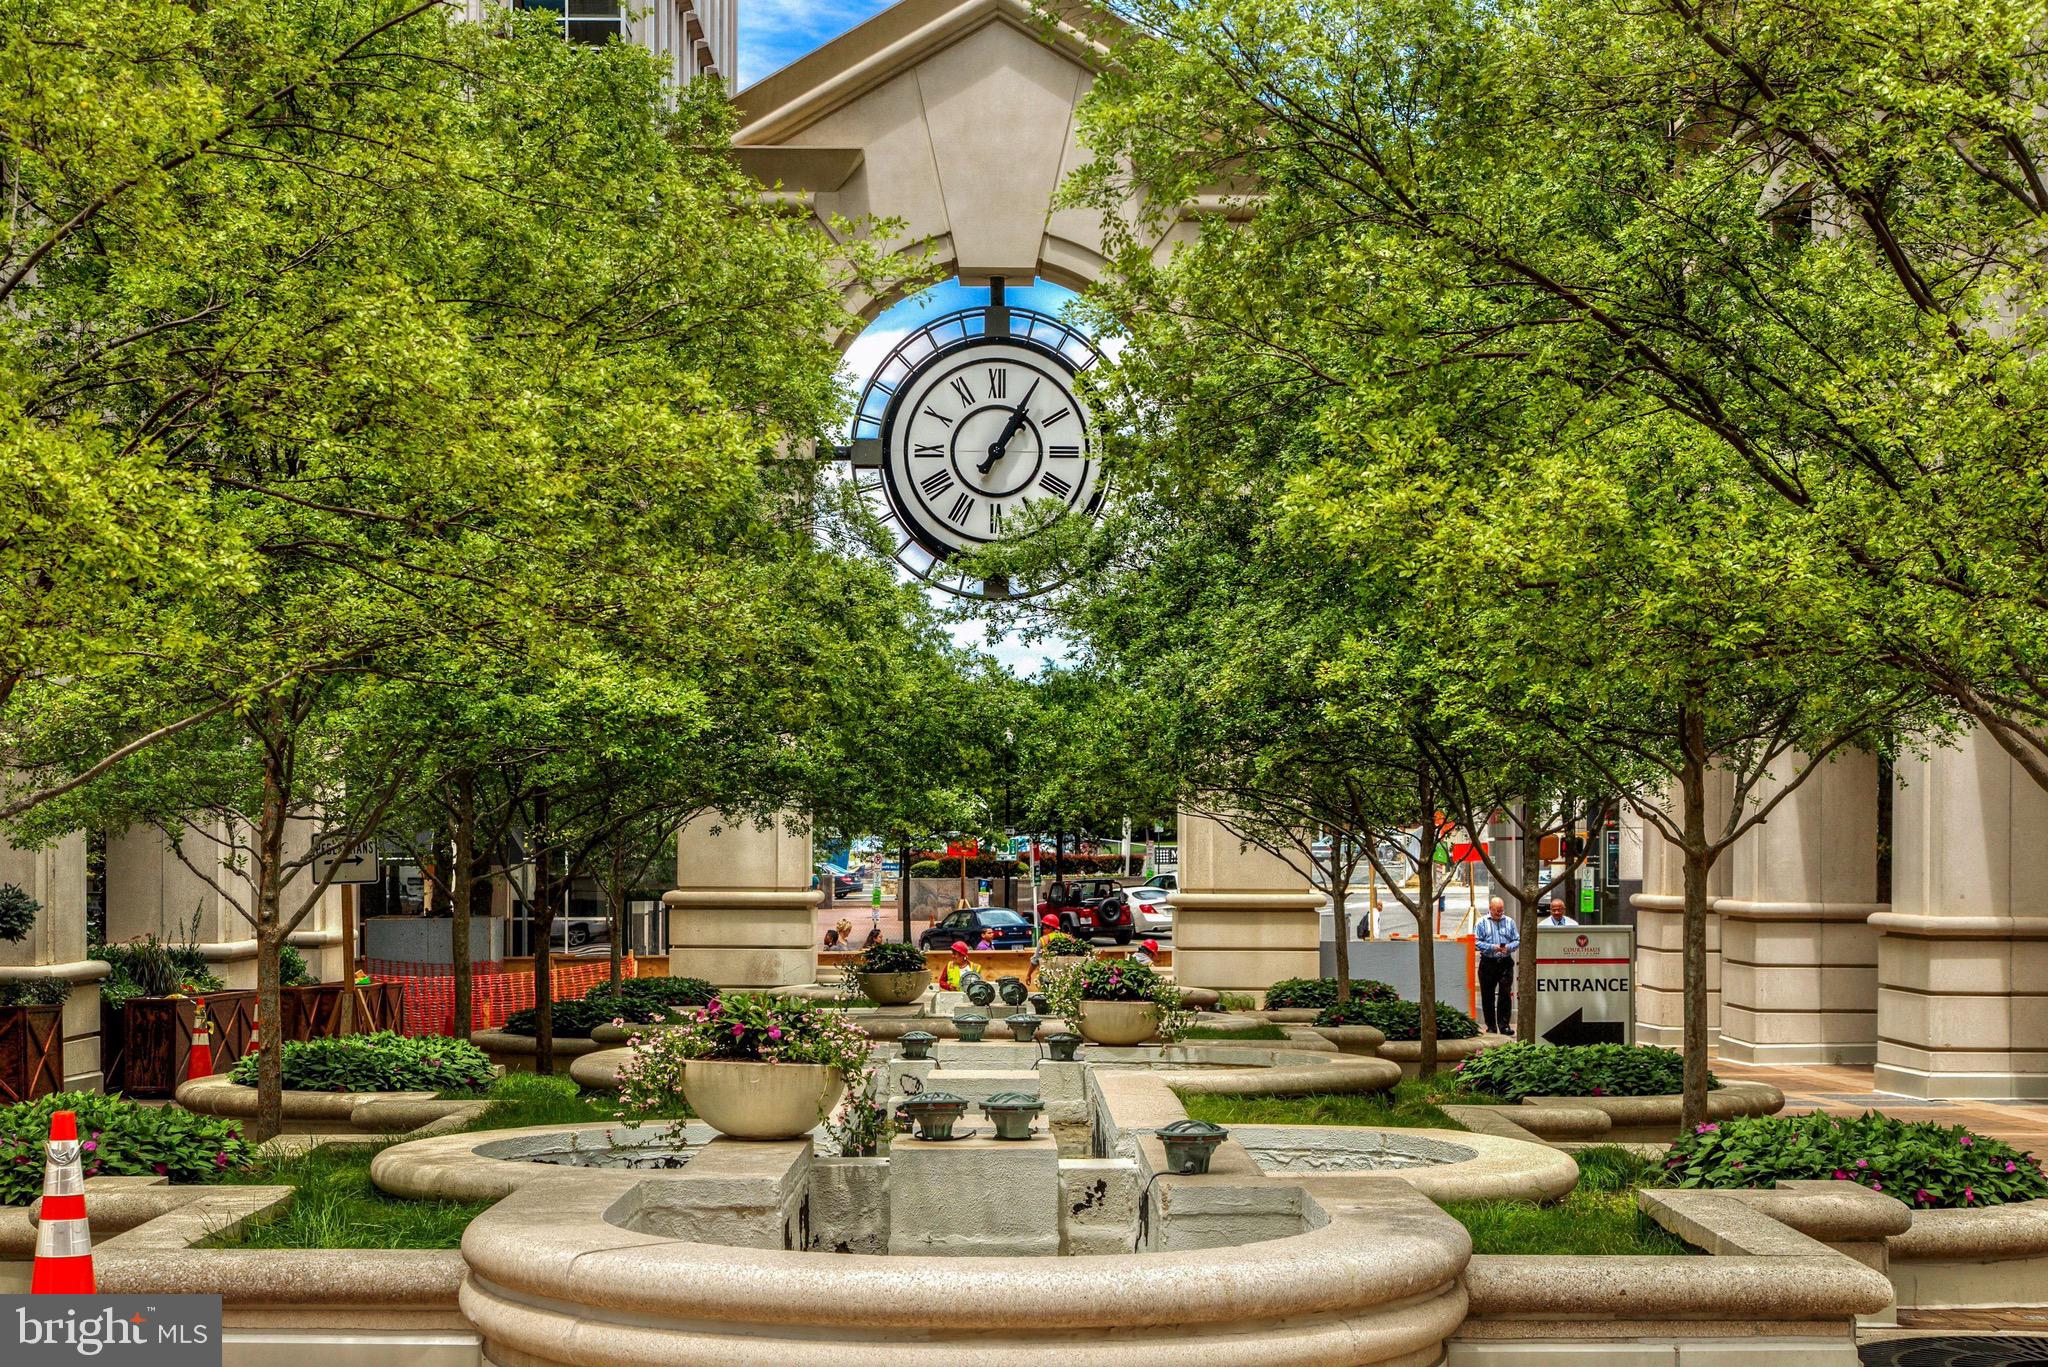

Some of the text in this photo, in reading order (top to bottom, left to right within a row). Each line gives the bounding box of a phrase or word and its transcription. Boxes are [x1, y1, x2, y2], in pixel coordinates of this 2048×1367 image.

[950, 376, 976, 409] XI
[988, 368, 1007, 399] XII
[1537, 978, 1629, 992] ENTRANCE
